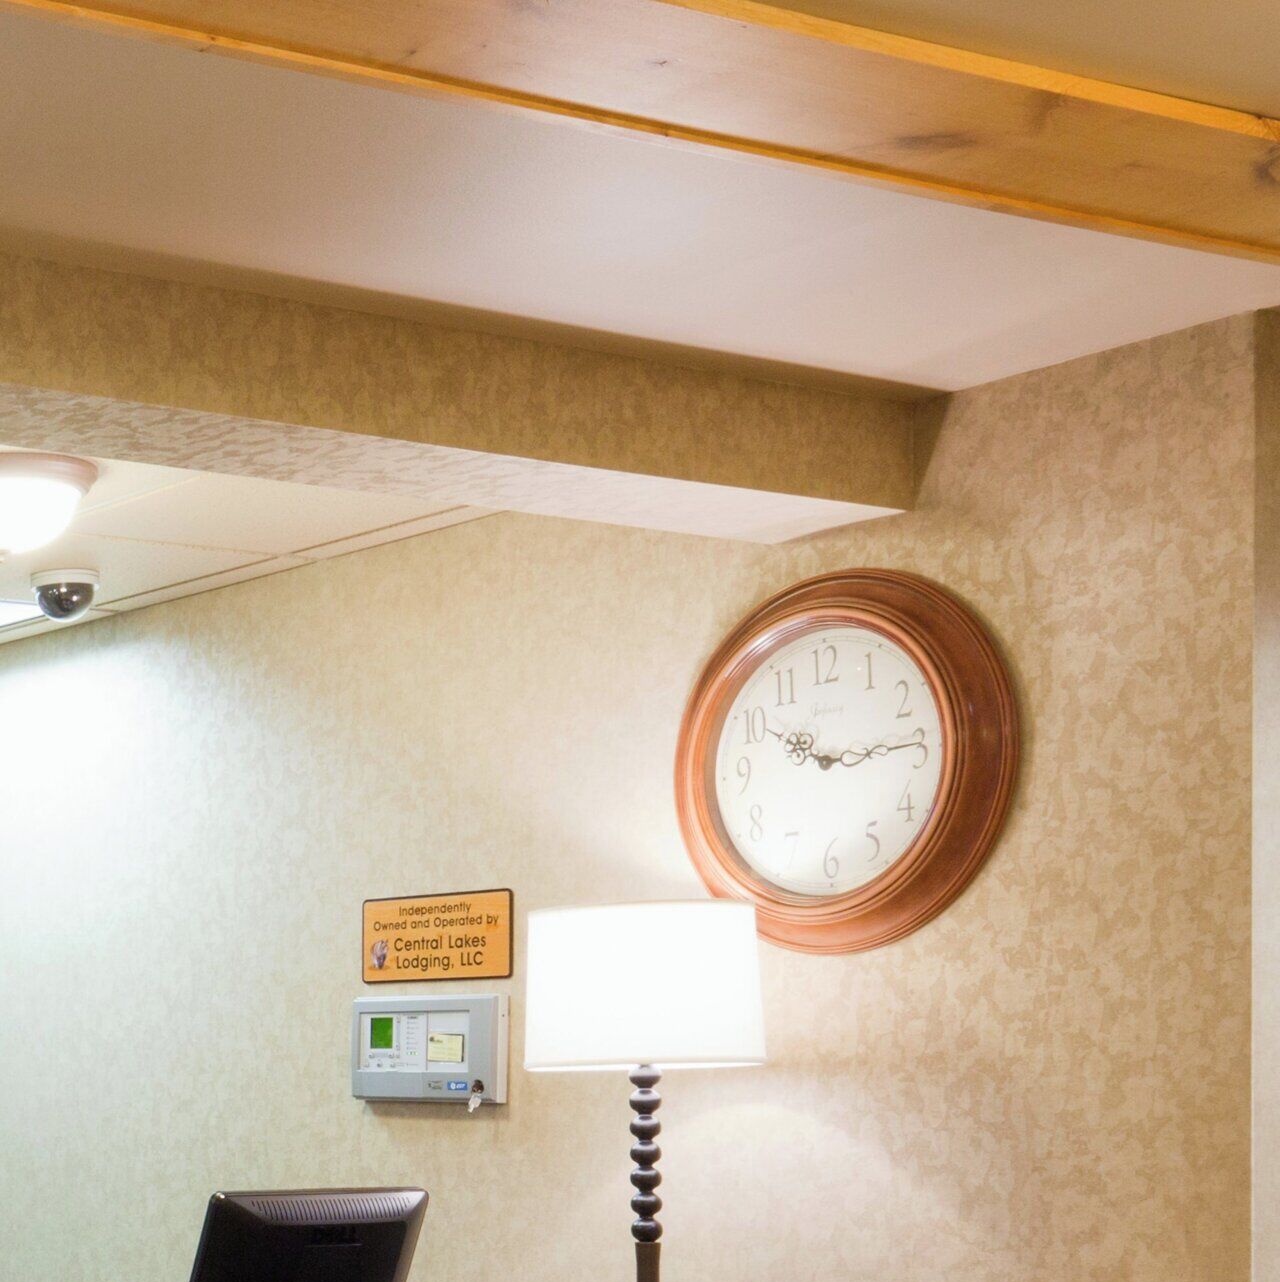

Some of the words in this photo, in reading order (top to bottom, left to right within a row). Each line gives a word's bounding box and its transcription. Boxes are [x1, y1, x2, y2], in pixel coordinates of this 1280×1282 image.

[811, 644, 840, 686] 12
[864, 651, 876, 691] 1
[774, 667, 797, 707] 11
[894, 679, 913, 719] 2
[743, 706, 766, 745] 10
[911, 727, 929, 769] 3
[736, 756, 751, 796] 9
[896, 779, 915, 823] 4
[749, 804, 764, 842] 8
[865, 820, 880, 863] 5
[784, 831, 800, 871] 7
[823, 837, 839, 879] 6
[373, 920, 407, 931] Owned
[410, 919, 430, 929] and
[434, 915, 482, 929] Operated
[486, 913, 499, 926] by
[398, 901, 471, 917] Independently
[394, 934, 443, 952] Central
[448, 933, 487, 949] Lakes
[396, 953, 454, 972] Lodging,
[460, 951, 484, 966] LLC
